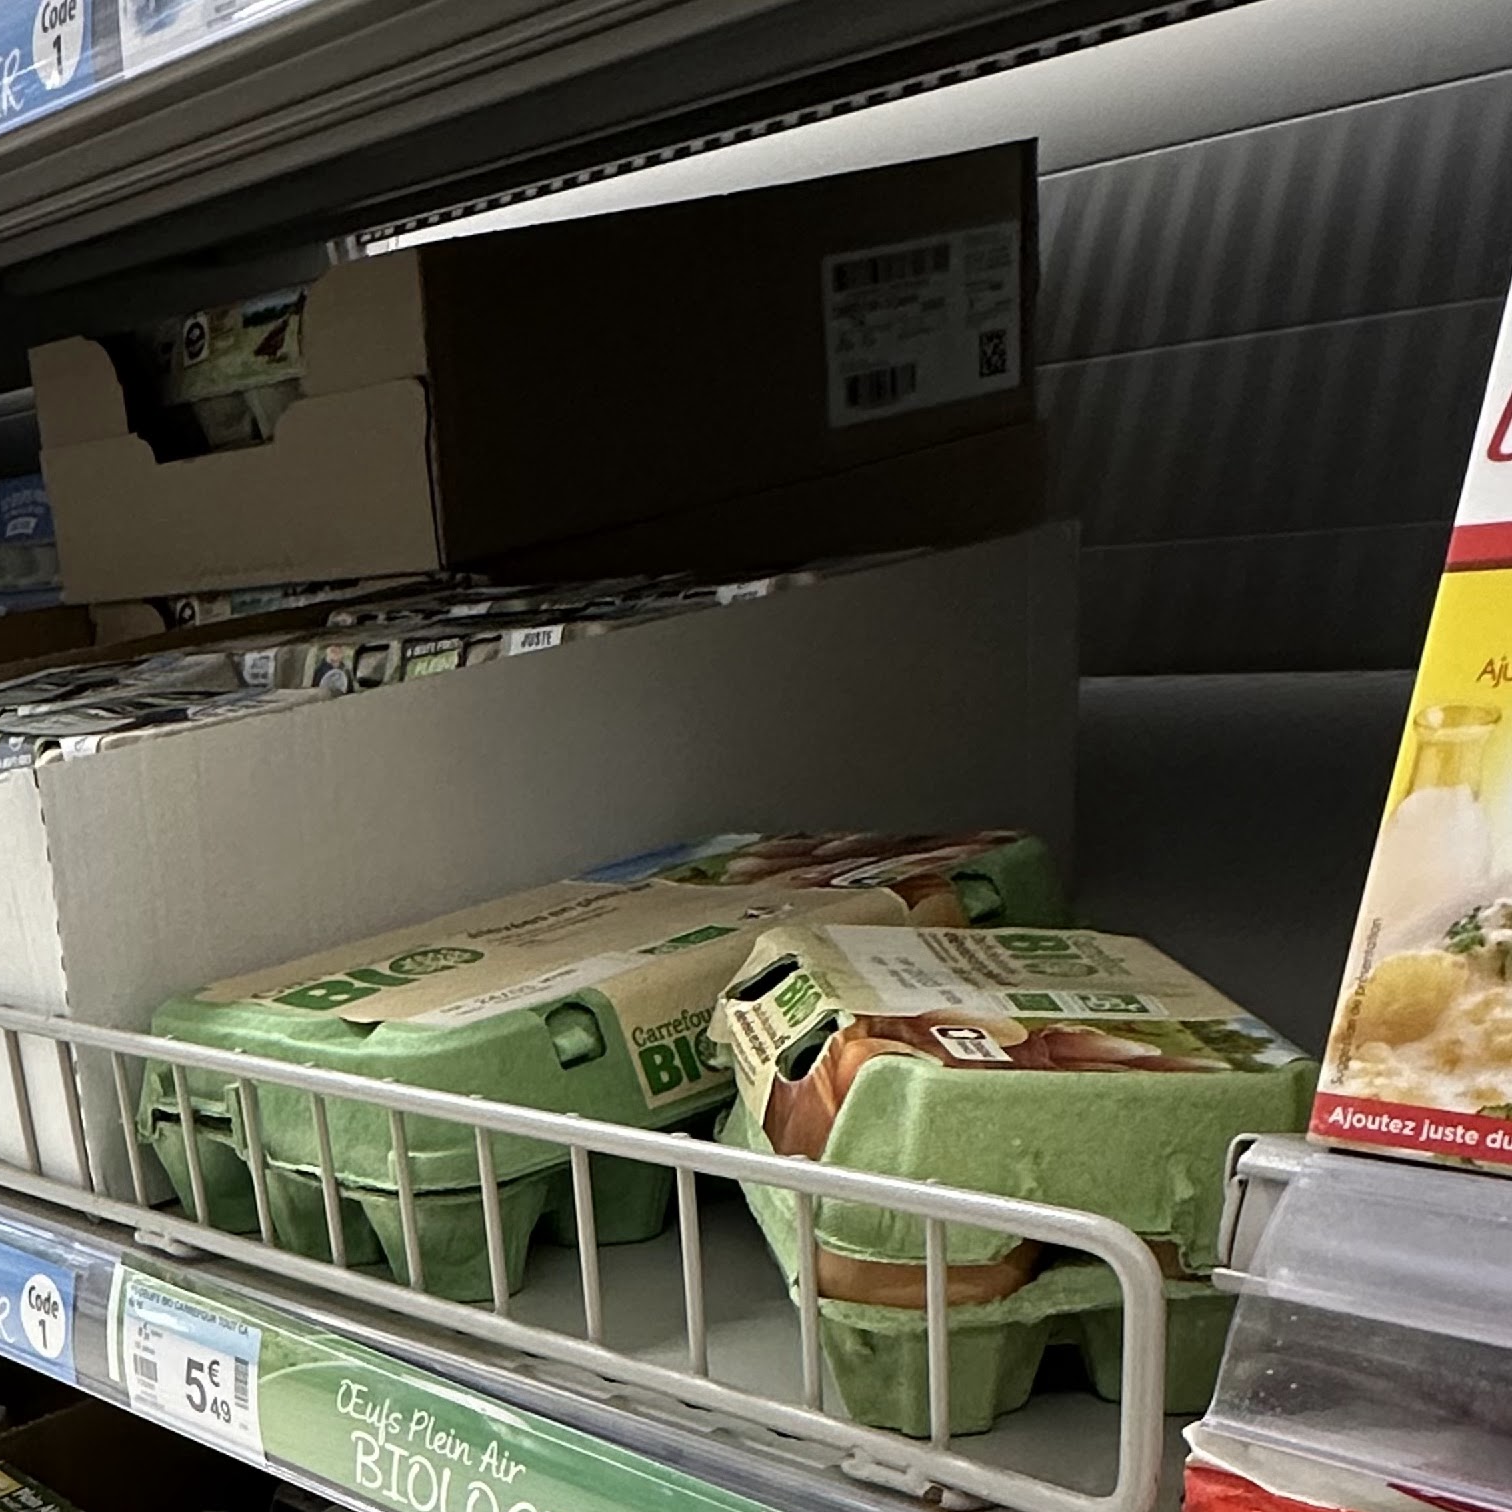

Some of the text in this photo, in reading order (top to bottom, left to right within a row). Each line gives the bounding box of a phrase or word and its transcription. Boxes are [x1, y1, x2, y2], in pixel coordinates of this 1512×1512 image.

[1328, 1106, 1417, 1137] Ajoutez
[1419, 1118, 1480, 1146] juste
[28, 1283, 61, 1320] Code
[39, 1318, 49, 1350] 1
[185, 1356, 221, 1414] 5 €
[210, 1396, 232, 1424] 49
[335, 1377, 527, 1485] Œufs Plein Air
